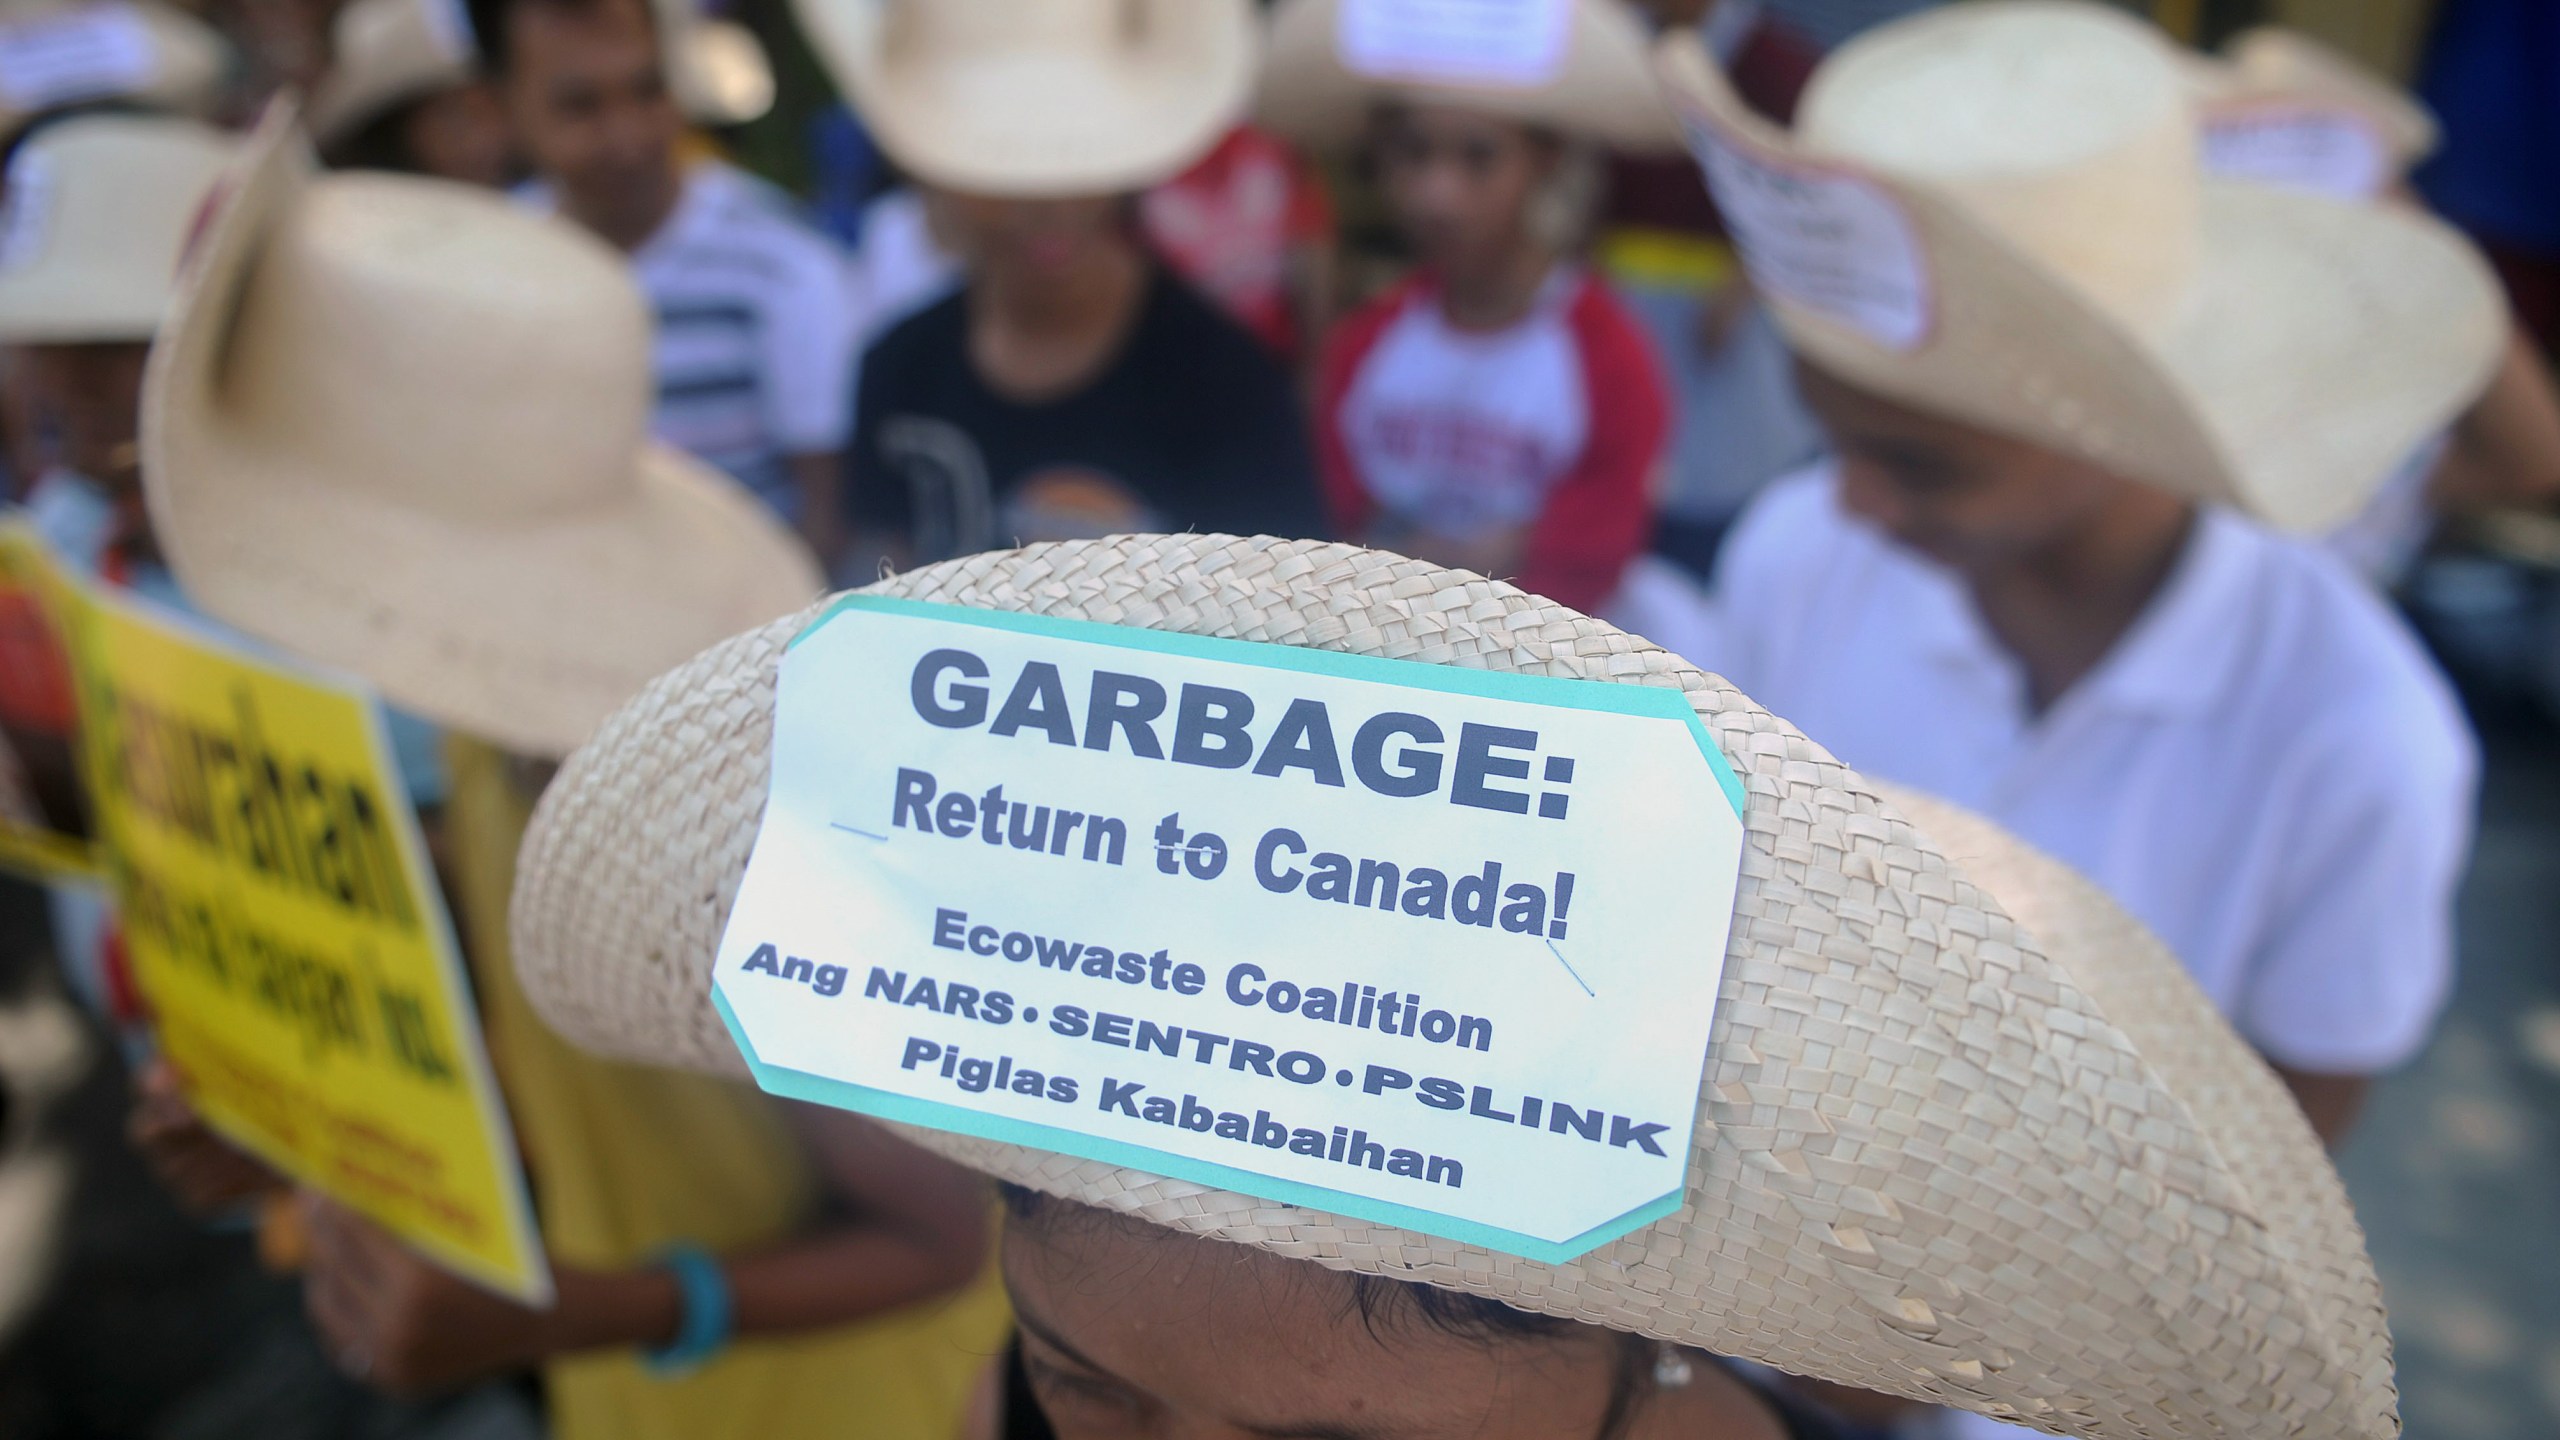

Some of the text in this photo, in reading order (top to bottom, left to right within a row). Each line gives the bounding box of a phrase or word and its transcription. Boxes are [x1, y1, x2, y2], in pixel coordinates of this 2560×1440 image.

[910, 648, 1575, 821] GARBAGE:
[892, 766, 1576, 941] Return to Canada!
[741, 943, 848, 997] Ang
[932, 907, 1493, 1052] Ecowaste Coalition
[901, 1036, 1464, 1189] Piglas Kababaihan
